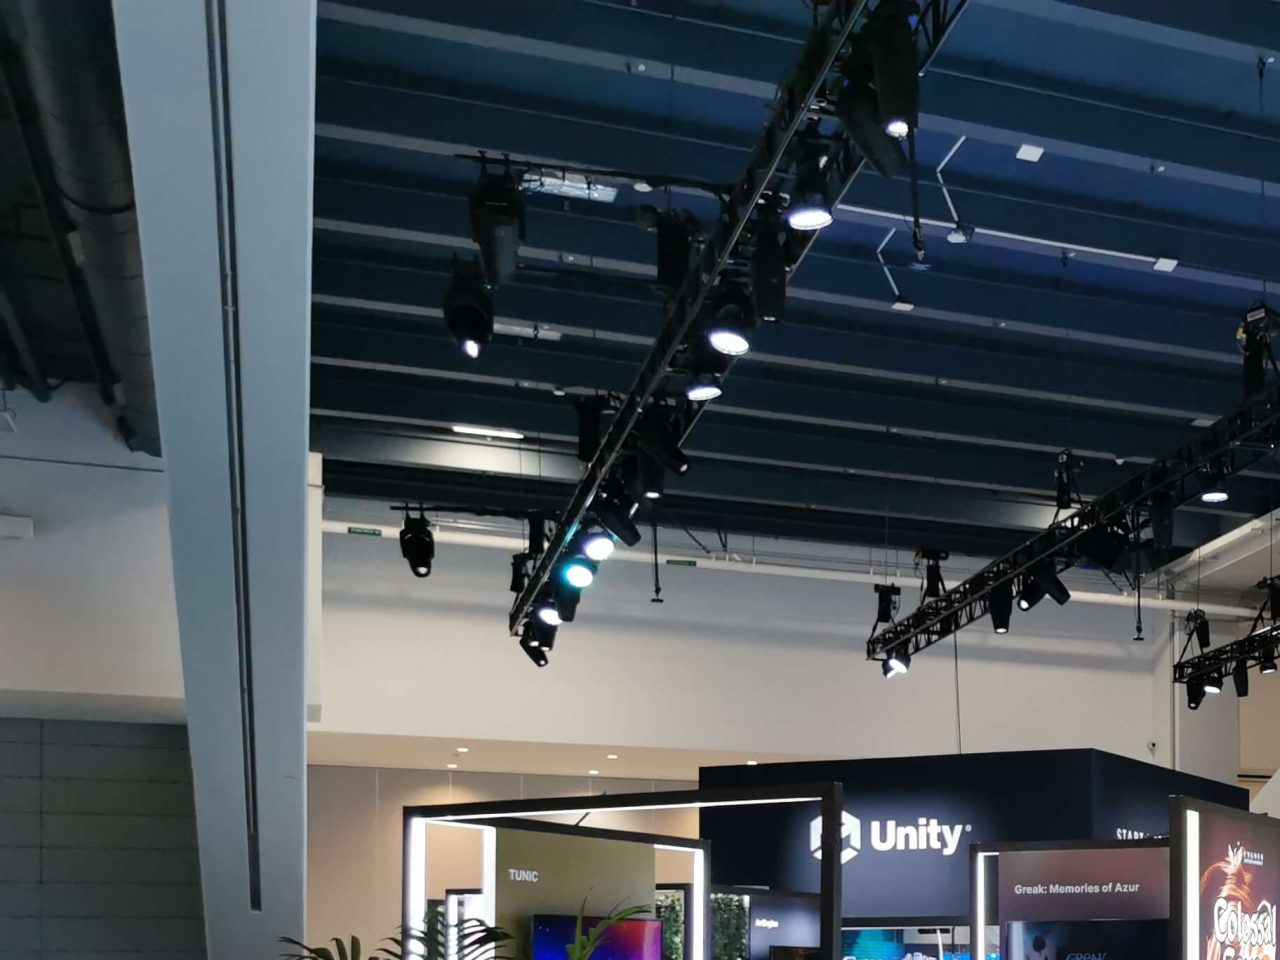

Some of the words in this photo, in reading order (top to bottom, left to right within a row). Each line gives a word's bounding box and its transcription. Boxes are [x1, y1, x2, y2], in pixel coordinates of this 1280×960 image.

[870, 818, 963, 855] Unity
[508, 869, 539, 882] TUNIC
[1014, 884, 1048, 895] Greak:
[1050, 883, 1099, 894] Memories
[1101, 883, 1113, 893] of
[1115, 883, 1140, 893] Azur
[1213, 897, 1277, 946] Colossal
